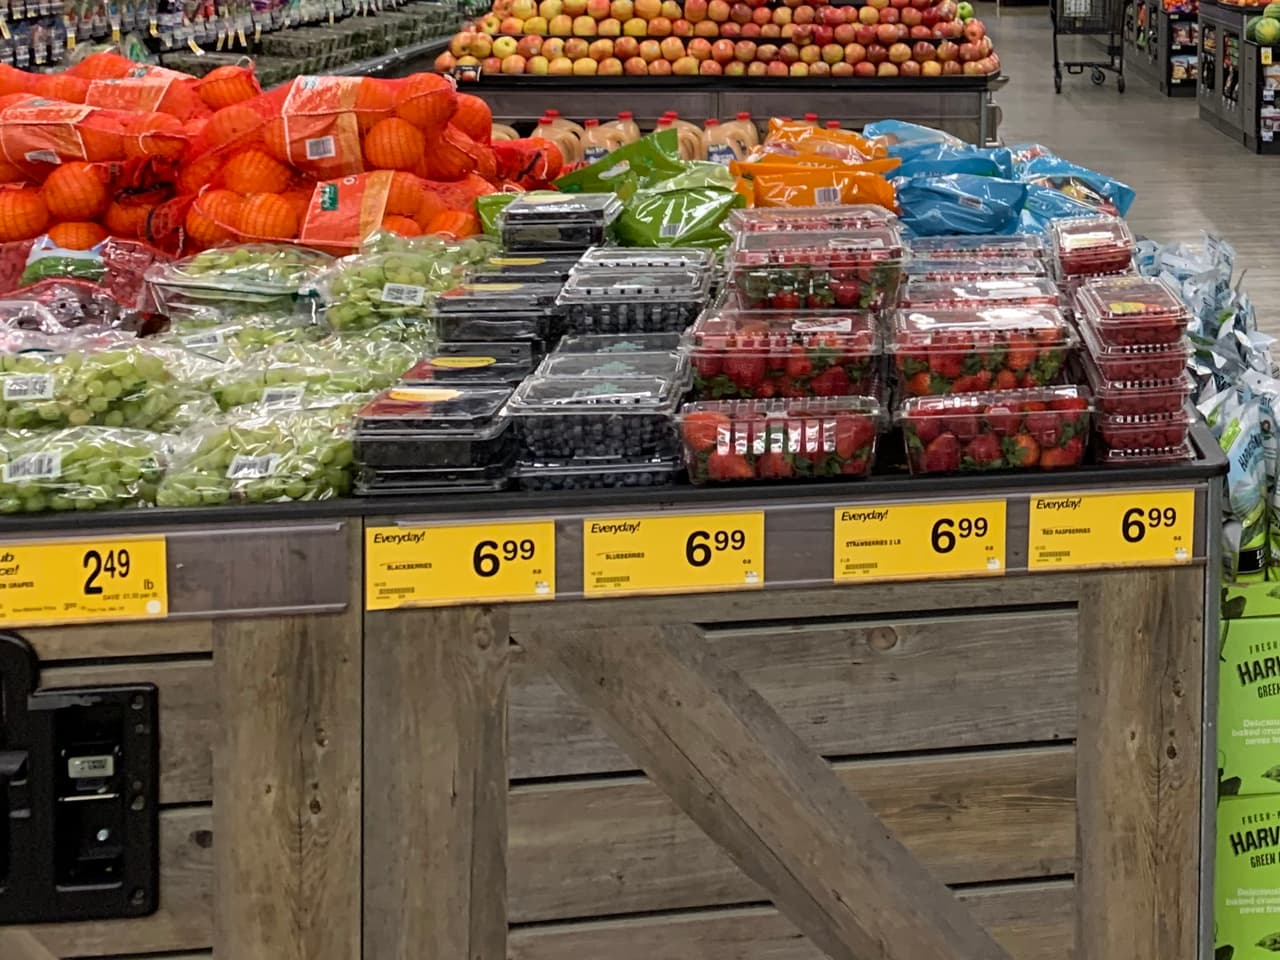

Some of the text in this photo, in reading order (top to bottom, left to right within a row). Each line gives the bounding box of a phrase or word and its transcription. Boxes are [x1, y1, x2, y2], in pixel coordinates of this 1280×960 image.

[1036, 498, 1082, 511] Everyday!
[841, 509, 889, 523] Everyday!
[591, 521, 641, 534] Everyday!
[373, 531, 425, 545] Everyday!
[143, 579, 154, 591] lb
[1251, 852, 1275, 868] GREEN
